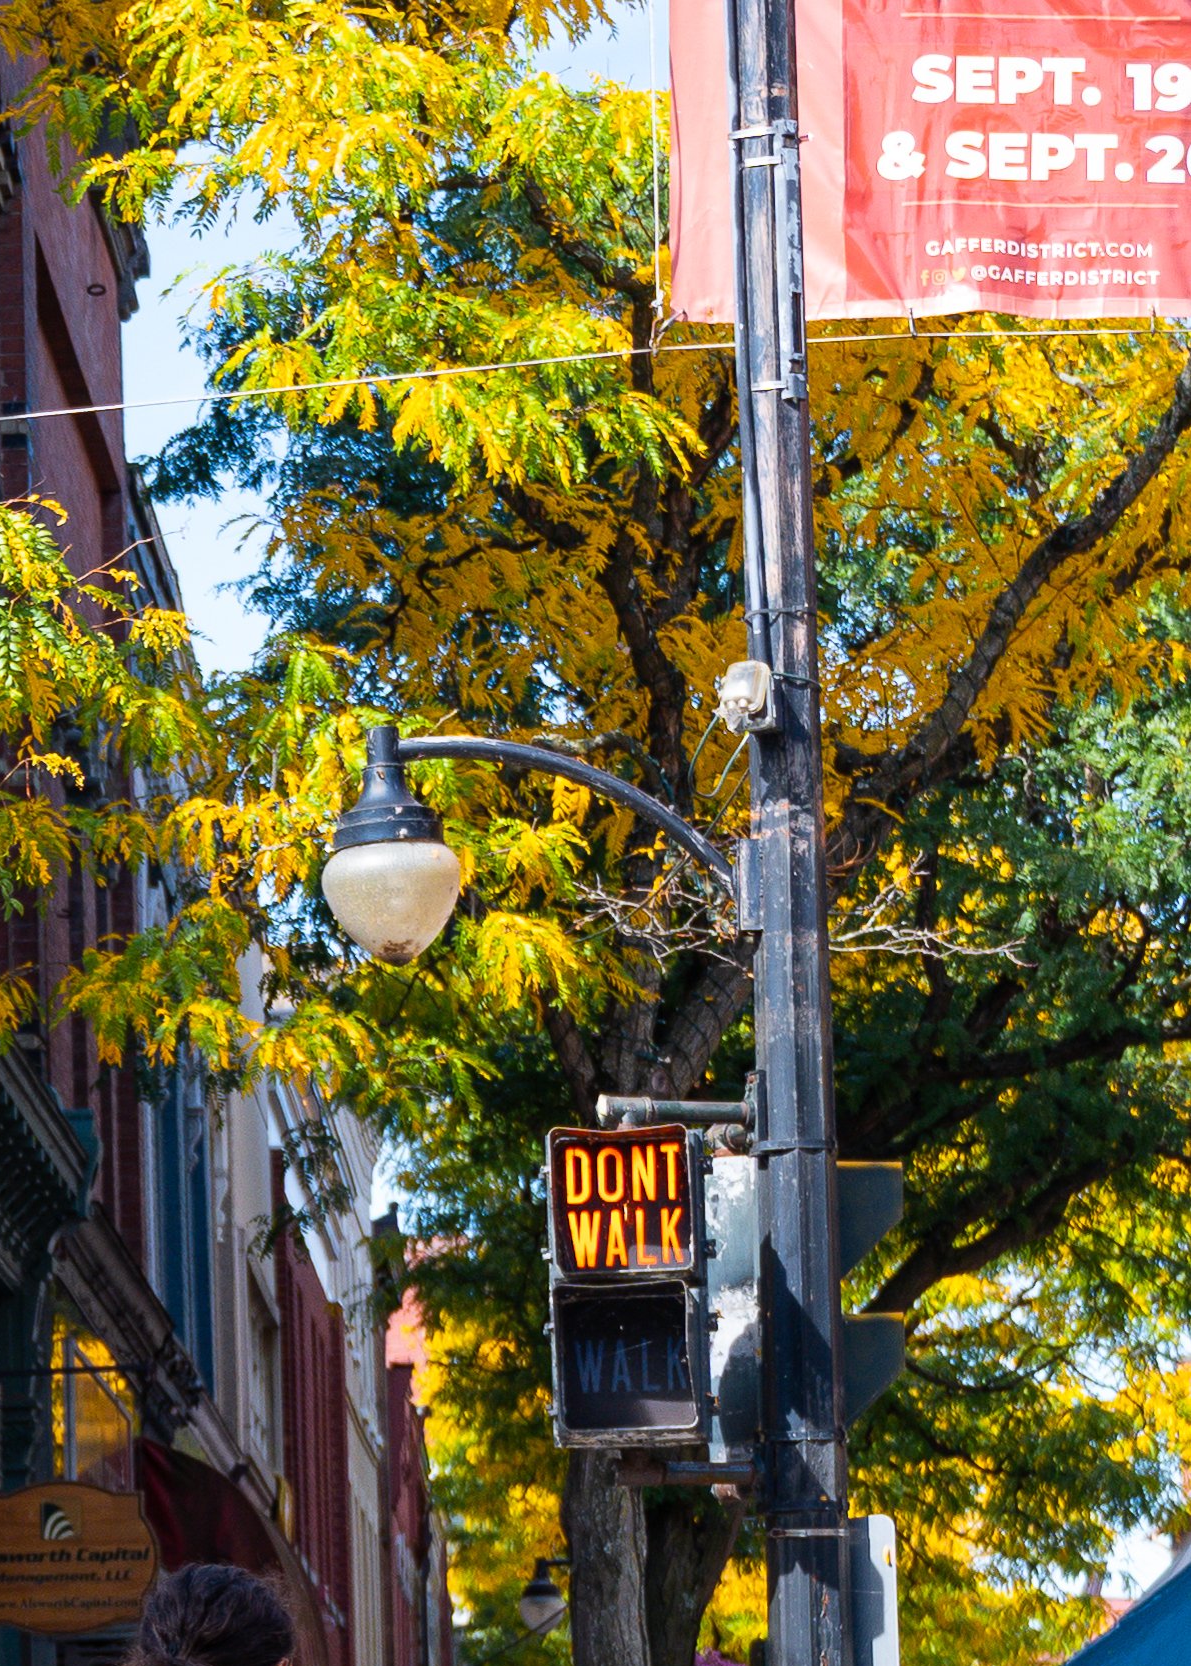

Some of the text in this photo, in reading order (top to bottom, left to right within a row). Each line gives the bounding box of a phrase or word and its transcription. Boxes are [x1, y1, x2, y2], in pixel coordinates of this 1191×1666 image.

[911, 53, 1191, 113] SEPT. 19
[876, 130, 1191, 184] & SEPT. 2
[924, 237, 1153, 260] GAFFERDISTRICT.COM
[970, 264, 1161, 287] @GAFFERDISTRICT
[565, 1142, 680, 1205] DONT
[567, 1206, 685, 1269] WALK
[574, 1336, 688, 1395] WALK
[76, 1546, 151, 1564] Capital
